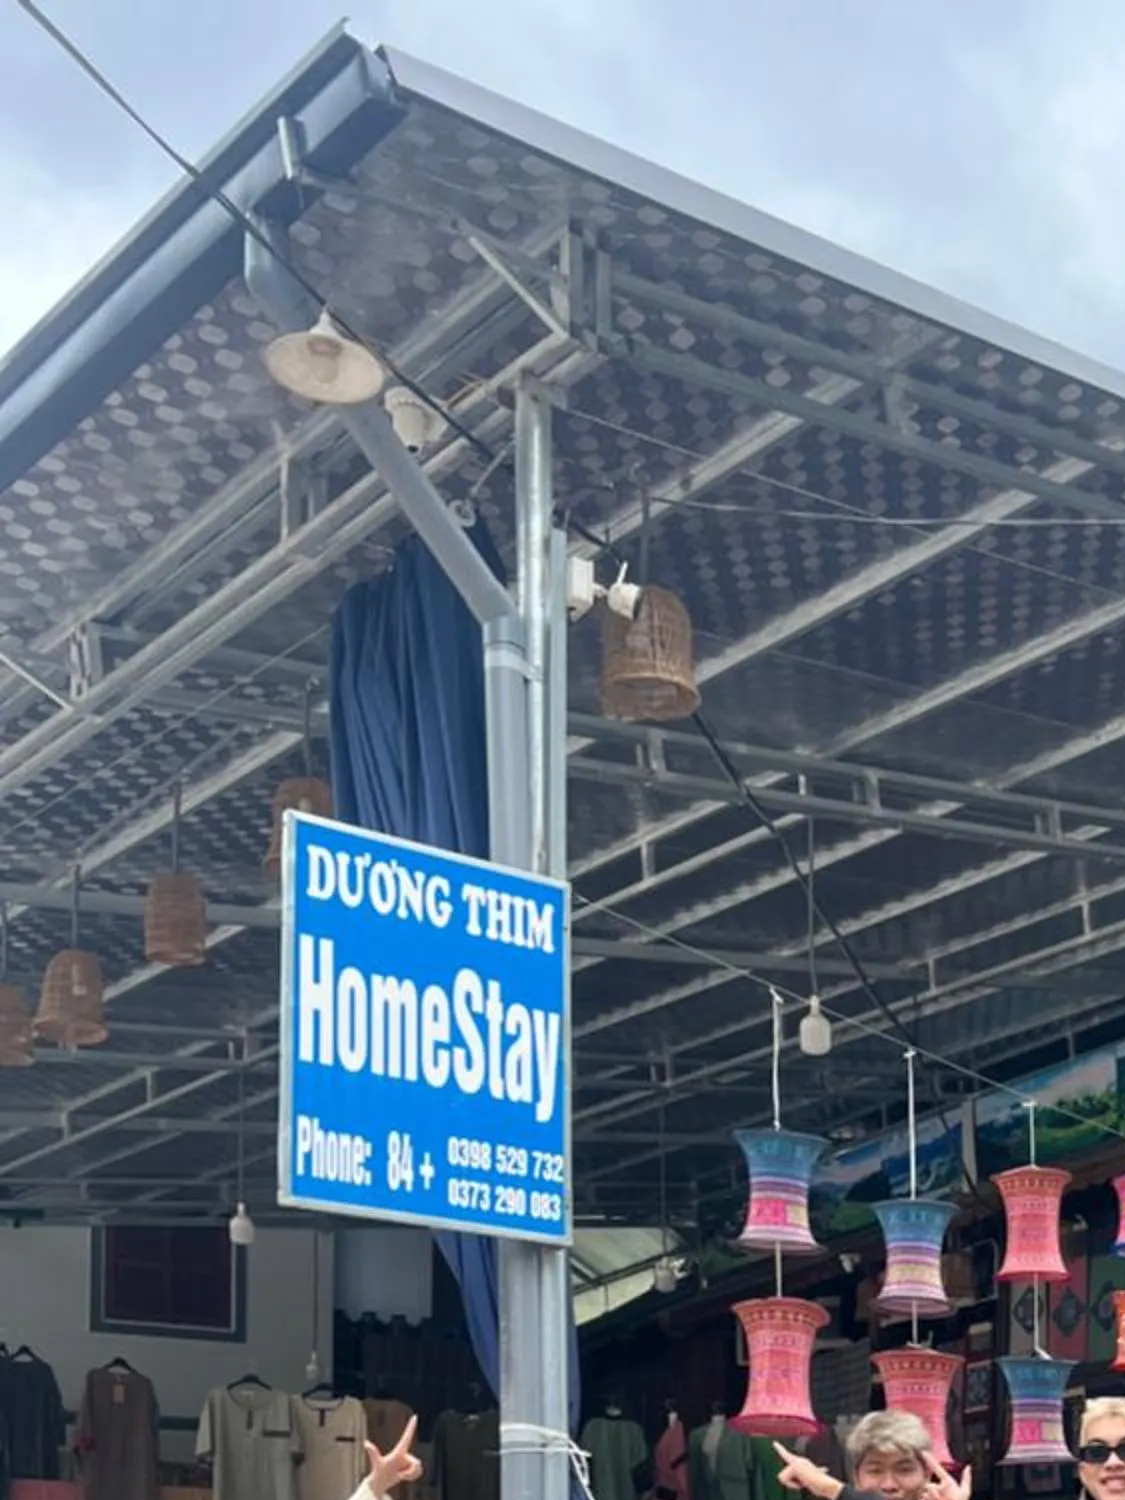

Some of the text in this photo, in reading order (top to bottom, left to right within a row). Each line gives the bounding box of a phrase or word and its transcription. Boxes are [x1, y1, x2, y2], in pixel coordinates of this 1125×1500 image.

[306, 844, 556, 954] DƯƠNG THIM
[299, 933, 561, 1123] HomeStay
[296, 1115, 373, 1186] Phone:
[387, 1131, 414, 1192] 84
[447, 1136, 564, 1184] 0398 529 732
[447, 1178, 562, 1221] 0373 290 083
